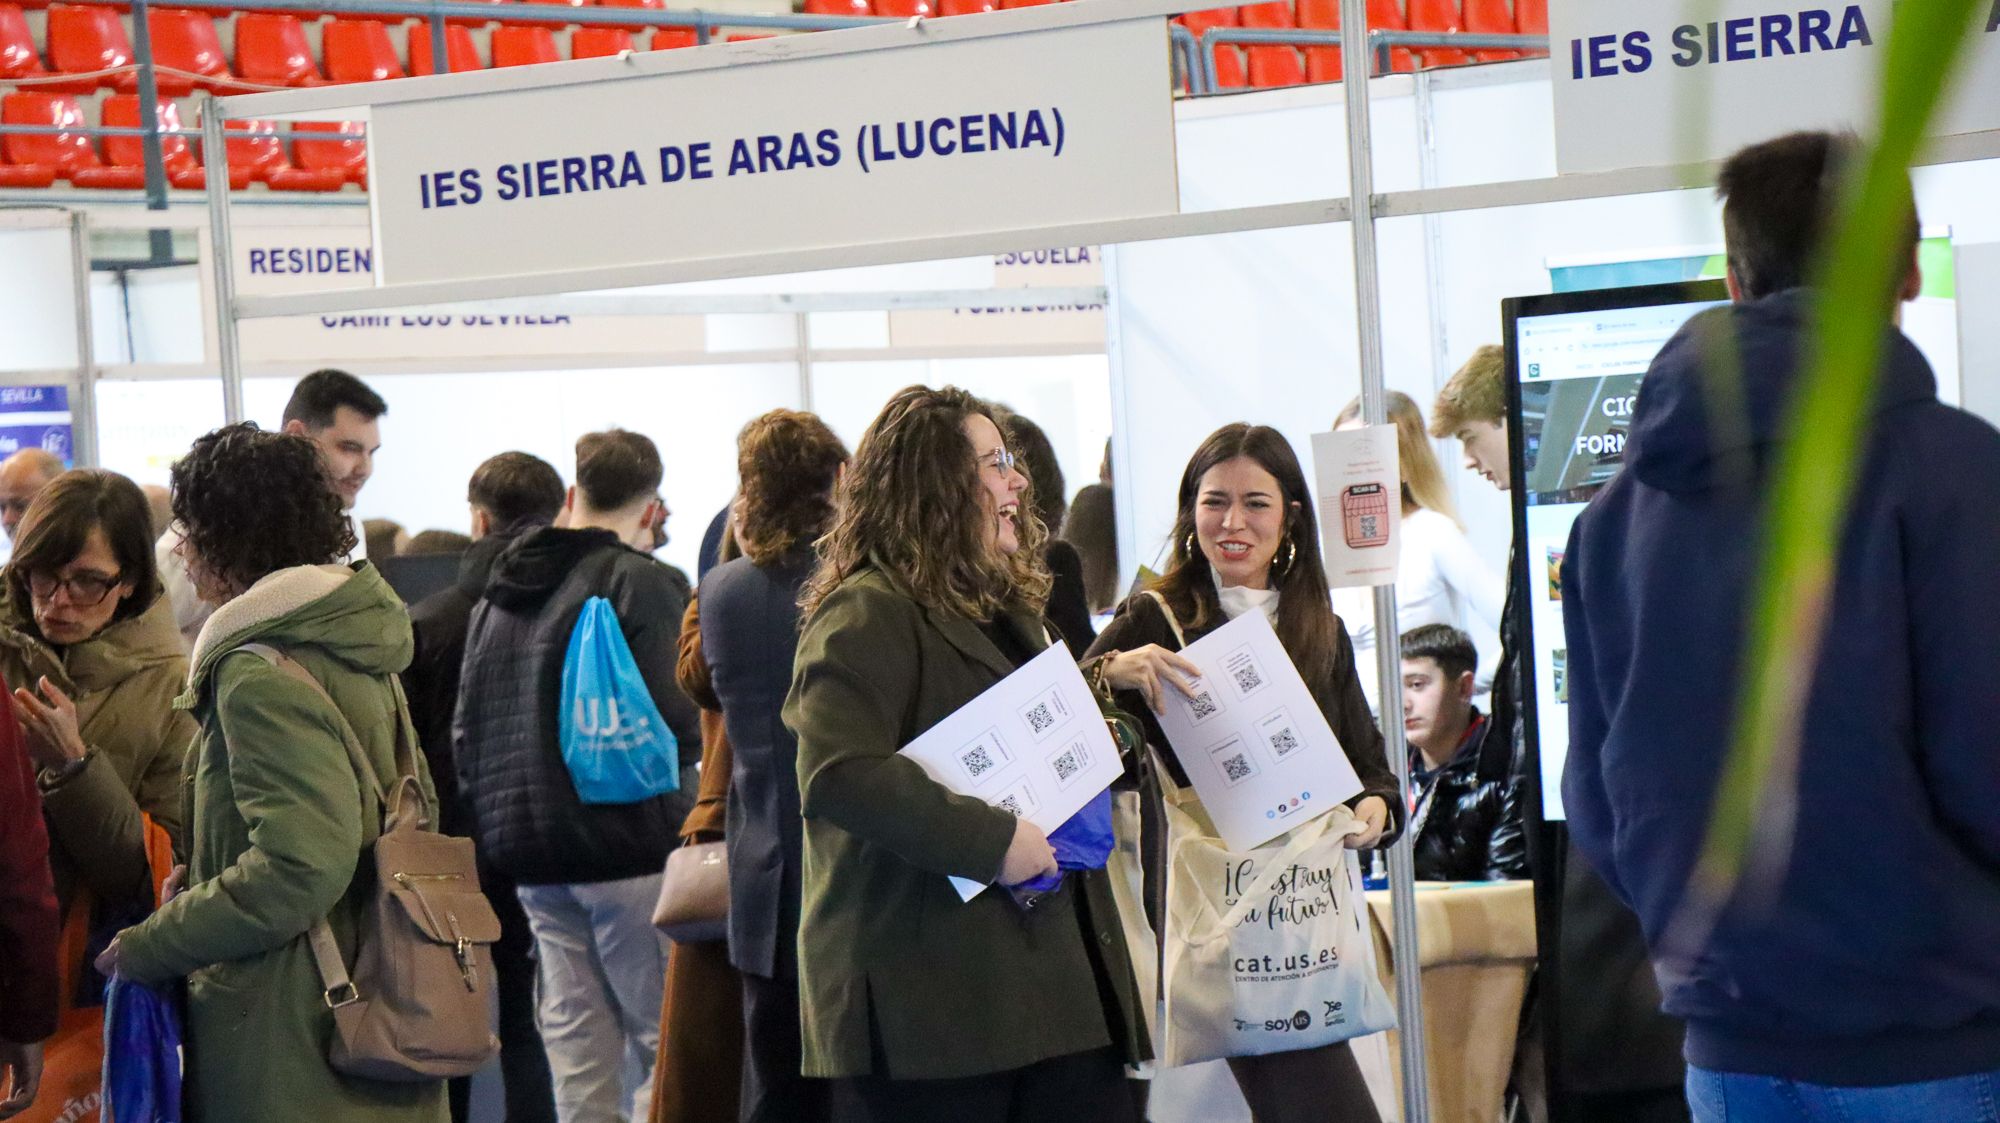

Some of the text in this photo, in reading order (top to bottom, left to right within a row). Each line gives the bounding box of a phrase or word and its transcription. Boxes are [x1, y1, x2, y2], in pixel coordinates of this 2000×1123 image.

[1571, 4, 1873, 80] IES SIERRA
[420, 107, 1065, 209] IES SIERRA DE ARAS (LUCENA)
[249, 247, 372, 274] RESIDEN
[995, 246, 1091, 265] SCUELA
[1234, 946, 1338, 973] cat.us.es
